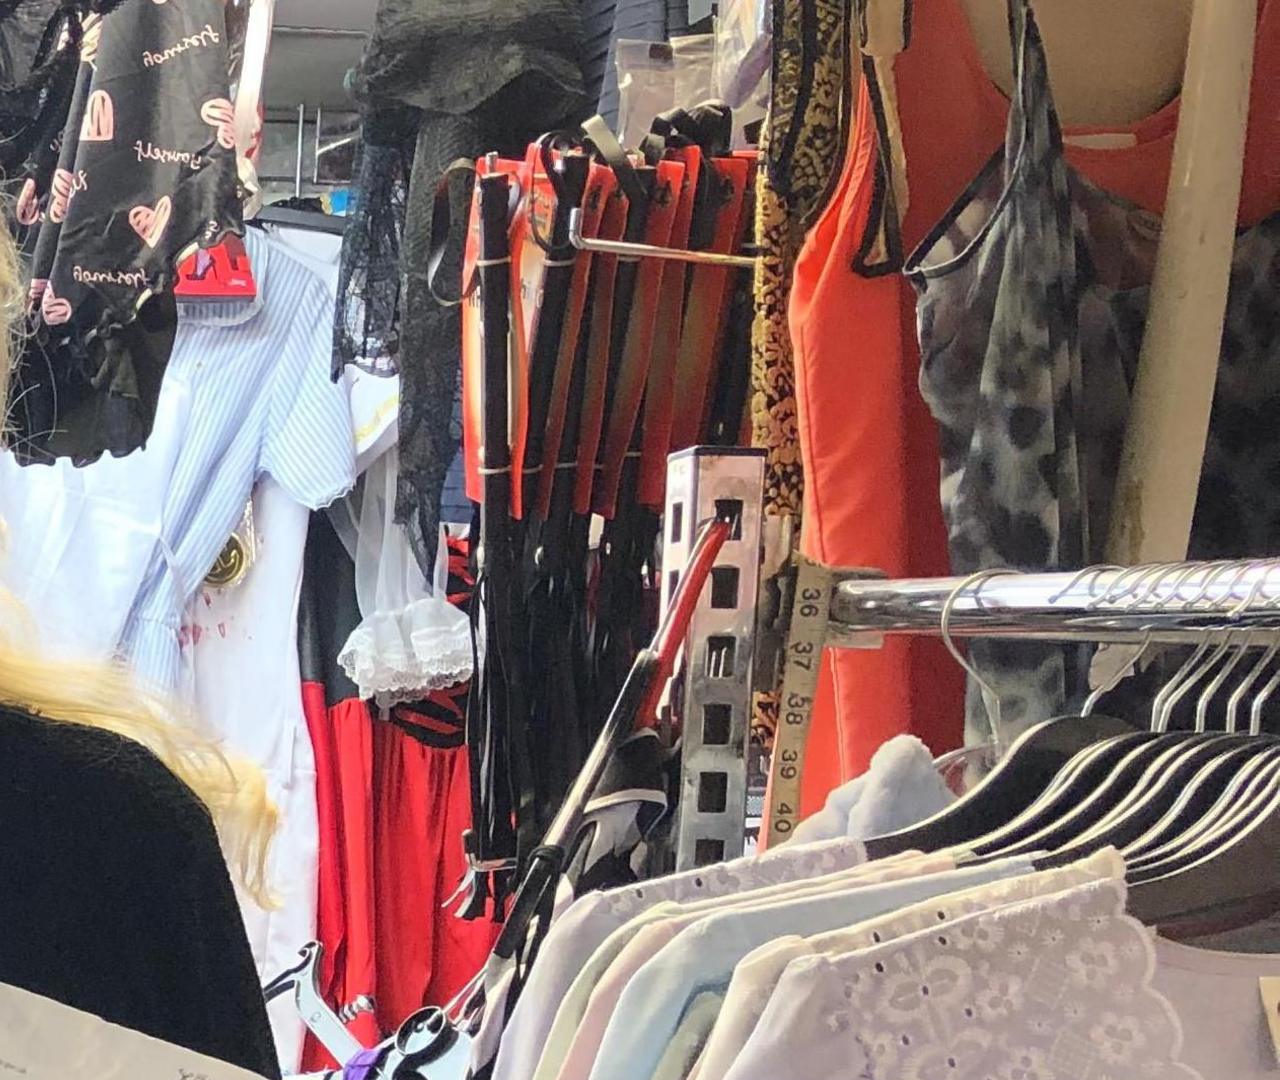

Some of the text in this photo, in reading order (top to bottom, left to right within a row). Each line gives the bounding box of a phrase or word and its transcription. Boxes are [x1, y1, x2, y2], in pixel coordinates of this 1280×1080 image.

[800, 588, 821, 618] 36
[792, 642, 813, 671] 37
[786, 693, 808, 725] 38
[780, 749, 798, 779] 39
[775, 802, 793, 833] 40
